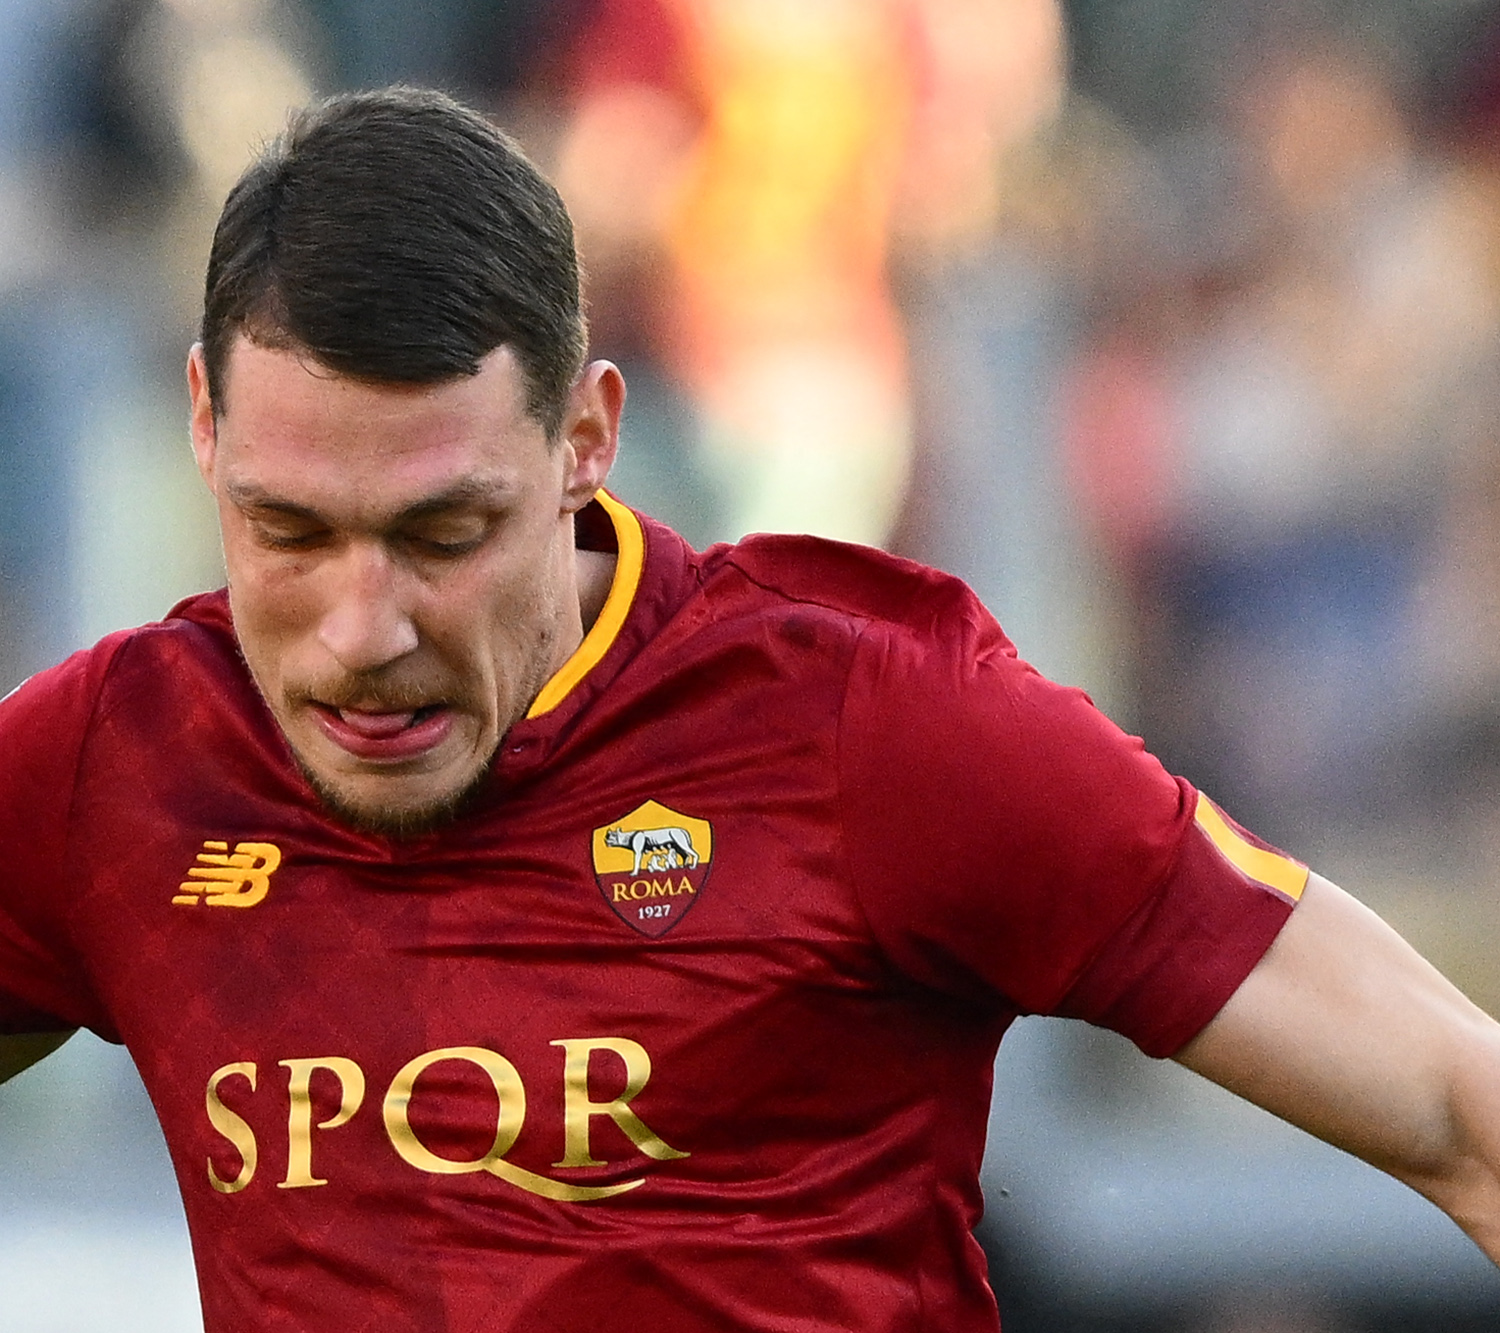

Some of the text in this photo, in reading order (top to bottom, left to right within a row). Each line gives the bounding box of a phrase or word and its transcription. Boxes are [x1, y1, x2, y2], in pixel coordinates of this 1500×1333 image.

[612, 876, 696, 902] ROMA
[638, 904, 672, 920] 1927
[206, 1037, 690, 1201] SPQR
